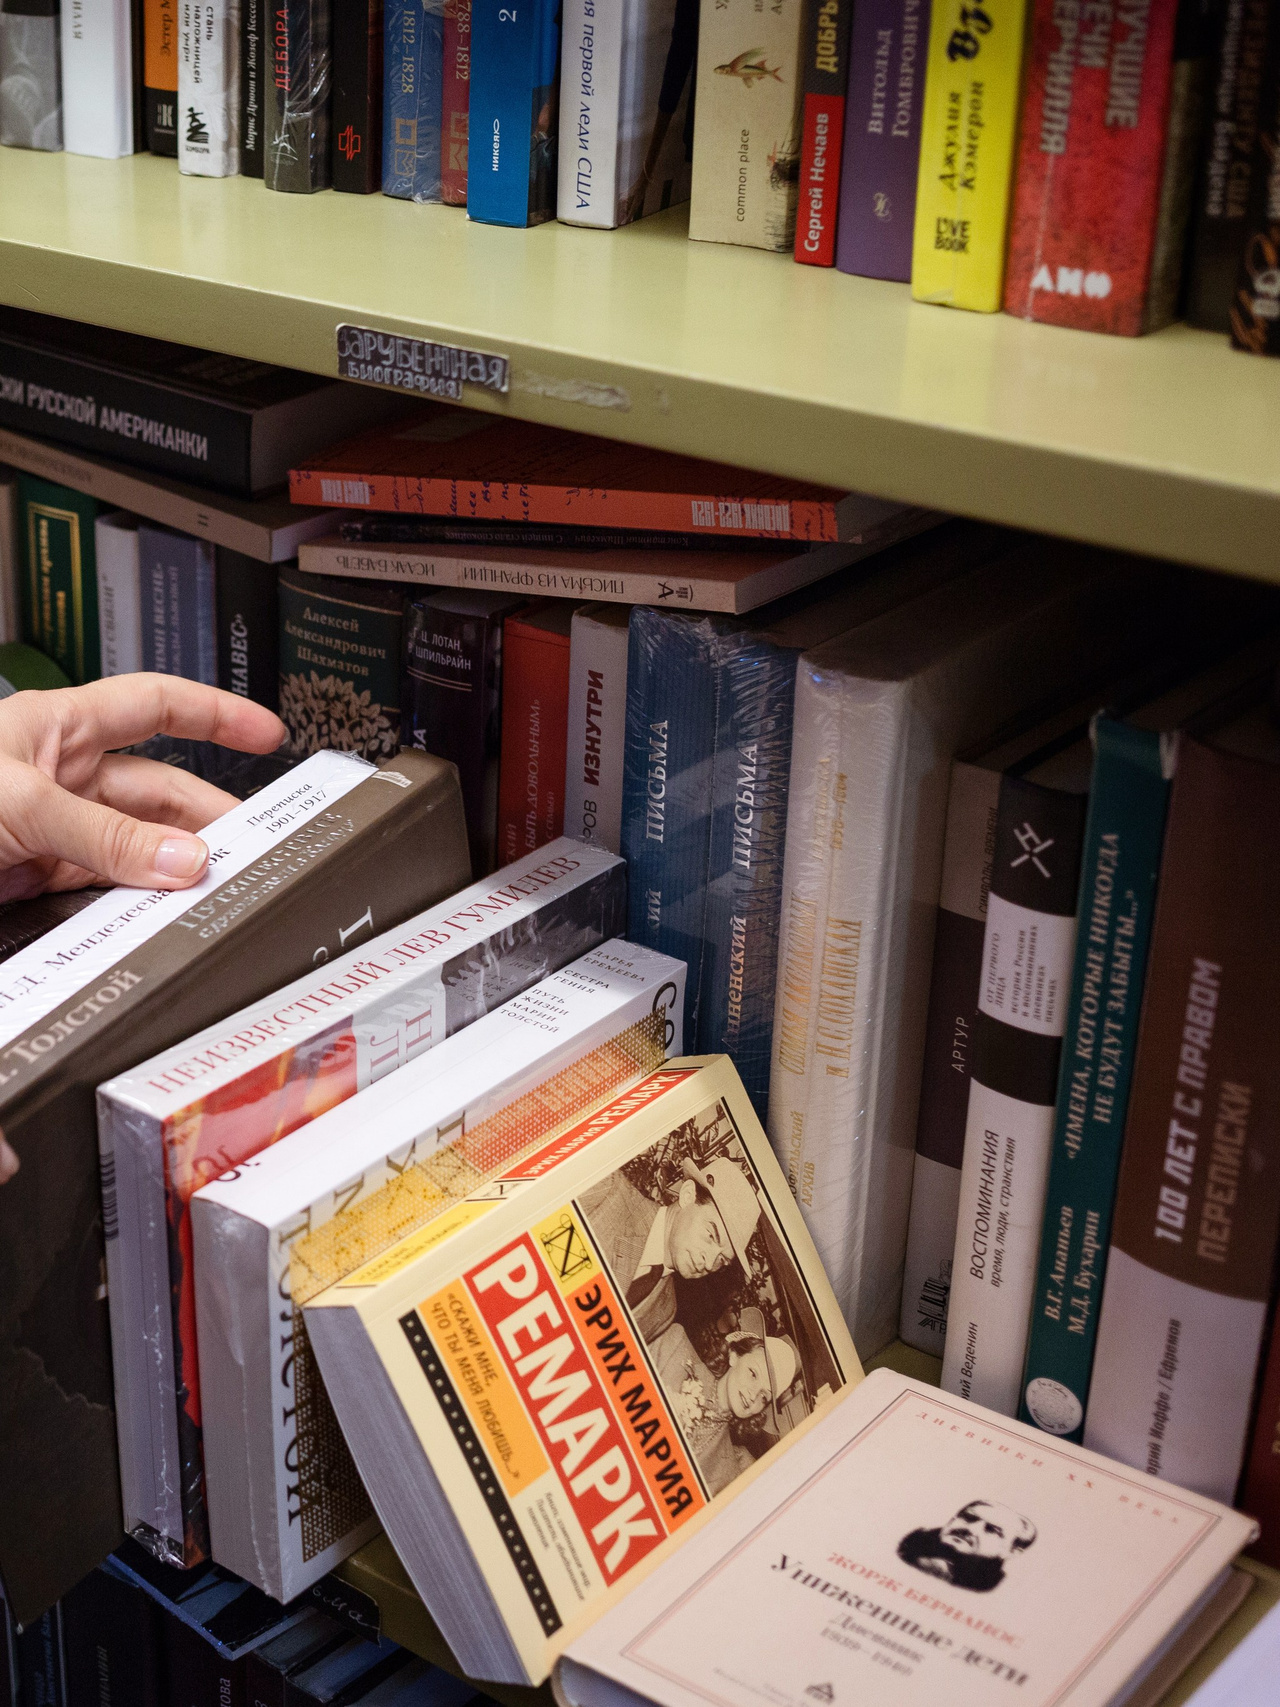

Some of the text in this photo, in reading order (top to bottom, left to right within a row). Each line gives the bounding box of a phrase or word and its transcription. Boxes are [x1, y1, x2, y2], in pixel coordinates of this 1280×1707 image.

[194, 5, 202, 84] наложницей
[206, 6, 214, 41] стань
[274, 8, 291, 92] ДЕБОРА
[498, 8, 517, 23] 2
[1080, 0, 1113, 69] ЕЧИ
[247, 33, 259, 69] Жозеф
[1039, 0, 1080, 155] ЕРЧИЛЛЯ
[246, 79, 258, 117] Дрюон
[575, 21, 595, 210] первой леди США
[245, 116, 258, 151] Морис
[736, 128, 750, 223] common place
[803, 112, 830, 253] Сергей Нечаев
[26, 382, 96, 427] РУССКОЙ
[99, 406, 209, 461] АМЕРИКАНКИ
[335, 555, 624, 595] ПИСЬМА ИЗ ФРАНЦИИ ИСААК БАБЕЛЬ
[284, 620, 386, 659] Александрович
[302, 605, 360, 633] Алексей
[296, 644, 370, 677] Шахматов
[415, 645, 472, 671] ШПИЛЬРАЙН
[582, 669, 604, 842] РОВ ИЗНУТРИ
[645, 719, 669, 844] ПИСЬМА
[245, 779, 318, 835] Переписка
[524, 810, 537, 849] БЫТЬ
[731, 743, 758, 870] ПИСЬМА
[1089, 831, 1121, 944] НИКОГДА
[41, 886, 174, 975] Менделеева
[592, 948, 636, 969] ДАРЬЯ
[146, 852, 581, 1095] НЕИЗВЕСТНЫЙ ЛЕВ ГУМИЛЕВ
[531, 985, 567, 1006] ПУТЬ
[552, 973, 597, 996] ГЕНИЯ
[563, 967, 611, 991] СЕСТРА
[583, 955, 647, 984] ЕРЕМЕЕВА
[1075, 945, 1107, 1063] КОТОРЫЕ
[499, 1007, 561, 1035] ТОЛСТОЙ
[510, 1000, 558, 1025] МАРИИ
[521, 992, 571, 1018] ЖИЗНИ
[951, 1015, 970, 1074] АРТУР
[1096, 1019, 1125, 1088] БУДУТ
[526, 1070, 684, 1179] ЭРИХ МАРИЯ РЕМАРК
[1093, 1091, 1117, 1124] НЕ
[1154, 957, 1222, 1244] 100 ЛЕТ С ПРАВОМ
[787, 1110, 804, 1198] ОФИЛЬСКИЙ
[801, 1160, 815, 1208] АРХИВ
[1196, 1080, 1252, 1263] ПЕРЕПИСКИ
[968, 1129, 1000, 1280] ВОСПОМИНАНИЯ
[990, 1136, 1016, 1288] время, люди, странствия
[1053, 1204, 1075, 1285] Ананьев
[1074, 1209, 1102, 1295] Бухарин
[428, 1301, 452, 1333] ЧТО
[442, 1331, 462, 1356] ТЫ
[453, 1354, 484, 1398] МЕНЯ
[443, 1290, 501, 1388] «СКАЖИ МНЕ,
[961, 1321, 979, 1379] Веденин
[1166, 1318, 1183, 1381] Ефремов
[472, 1240, 657, 1577] РЕМАРК
[574, 1282, 693, 1518] ЭРИХ МАРИЯ
[957, 1644, 1031, 1688] дети
